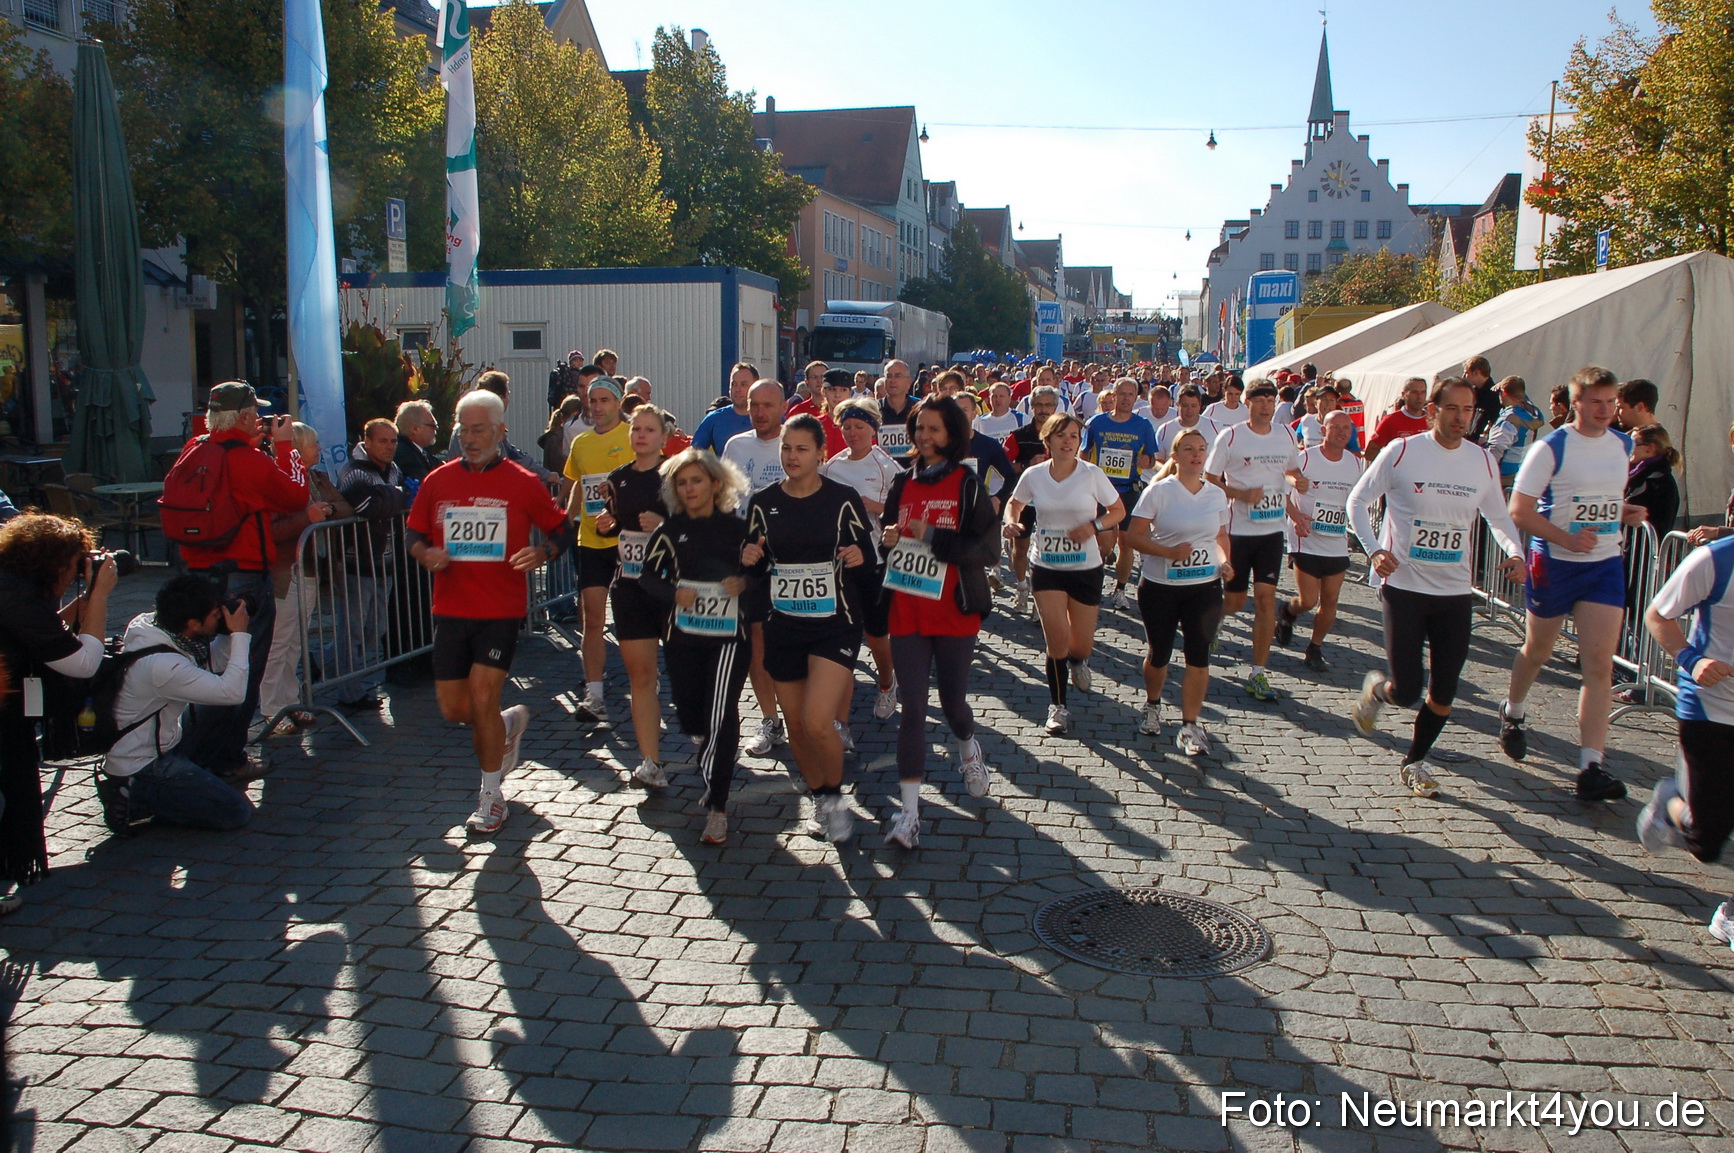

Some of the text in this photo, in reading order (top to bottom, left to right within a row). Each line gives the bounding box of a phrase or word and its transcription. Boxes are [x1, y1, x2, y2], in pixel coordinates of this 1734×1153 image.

[390, 203, 401, 233] P
[1600, 245, 1607, 264] P
[1258, 279, 1294, 298] maxi
[1040, 307, 1057, 320] axi
[1105, 455, 1125, 468] 366
[1436, 488, 1470, 498] MENARINI
[1316, 508, 1346, 525] 2090
[1575, 502, 1618, 521] 2949
[450, 521, 500, 542] 2807
[1415, 529, 1462, 550] 2818
[892, 550, 939, 578] 2806
[1045, 553, 1081, 563] Susanne
[1415, 548, 1457, 561] Joachim
[1176, 568, 1206, 578] Bianca
[777, 577, 828, 599] 2765
[682, 596, 732, 617] 627
[790, 600, 818, 611] Julia
